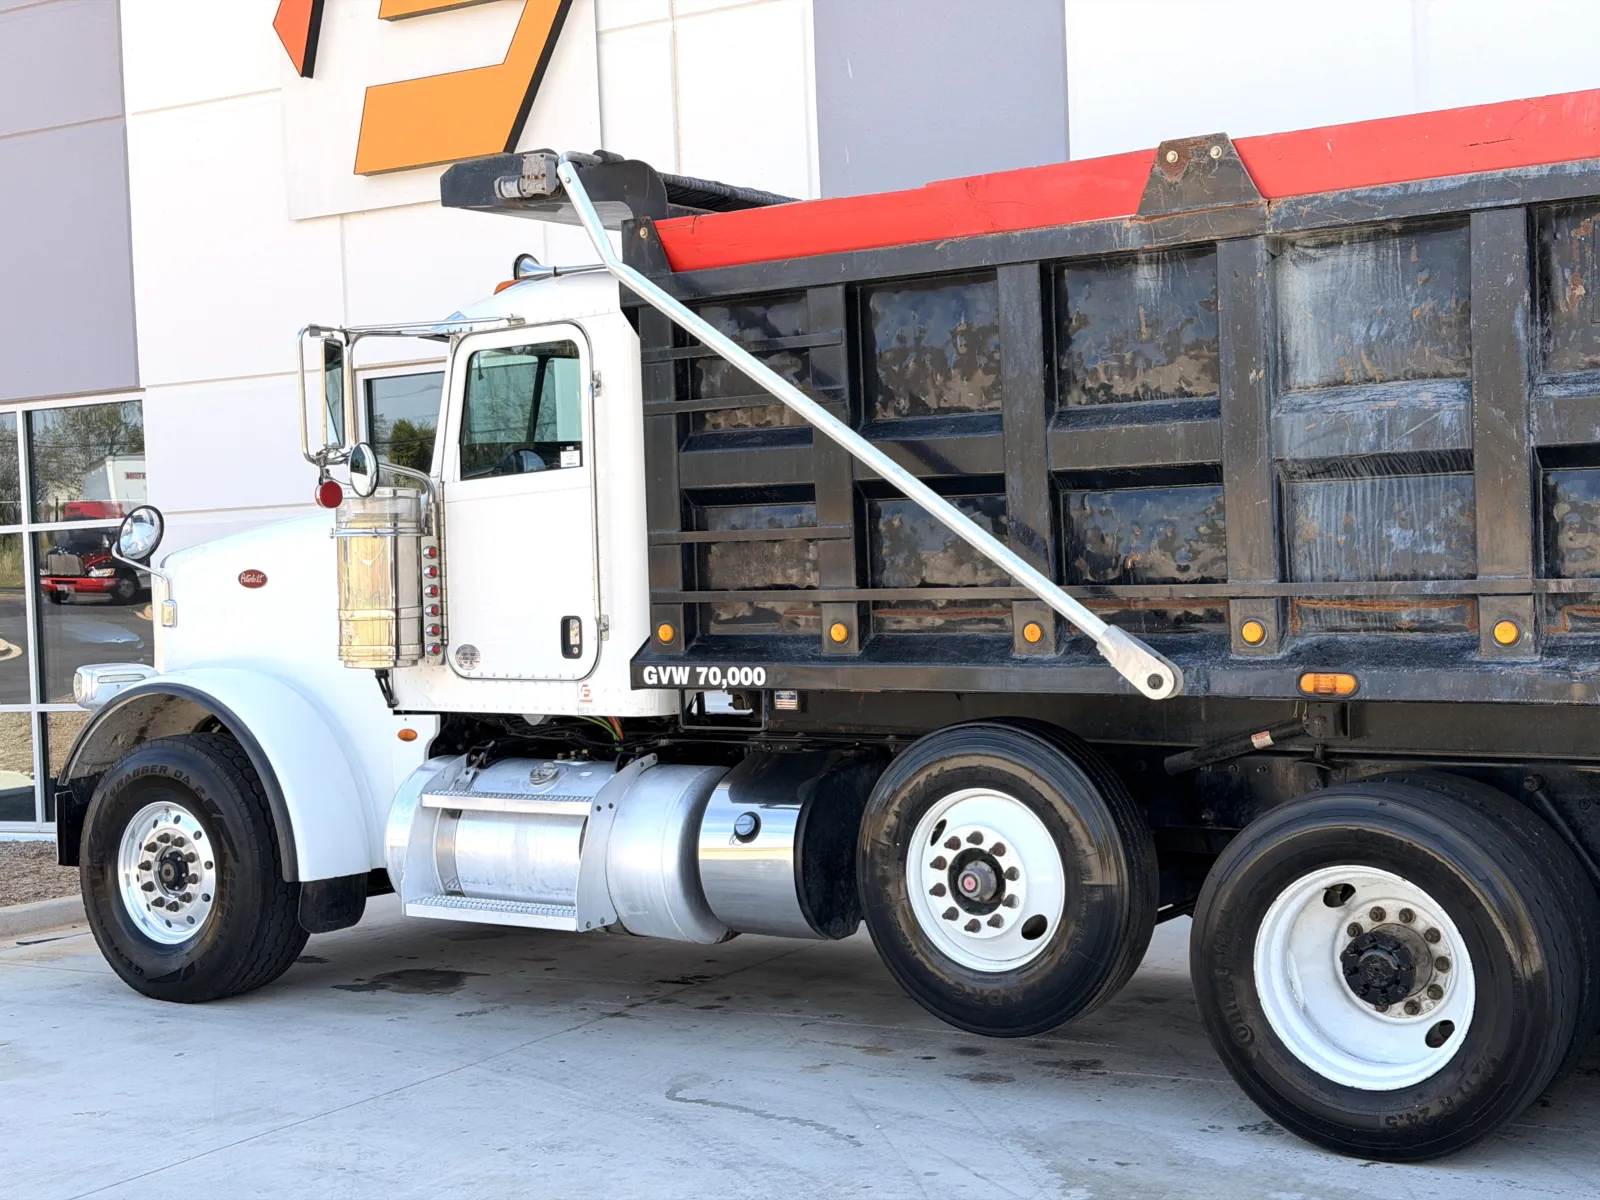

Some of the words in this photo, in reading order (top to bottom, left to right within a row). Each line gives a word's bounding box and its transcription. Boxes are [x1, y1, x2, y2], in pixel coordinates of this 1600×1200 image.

[643, 666, 690, 685] GVW
[696, 667, 766, 688] 70,000
[109, 764, 169, 797] GRABBER
